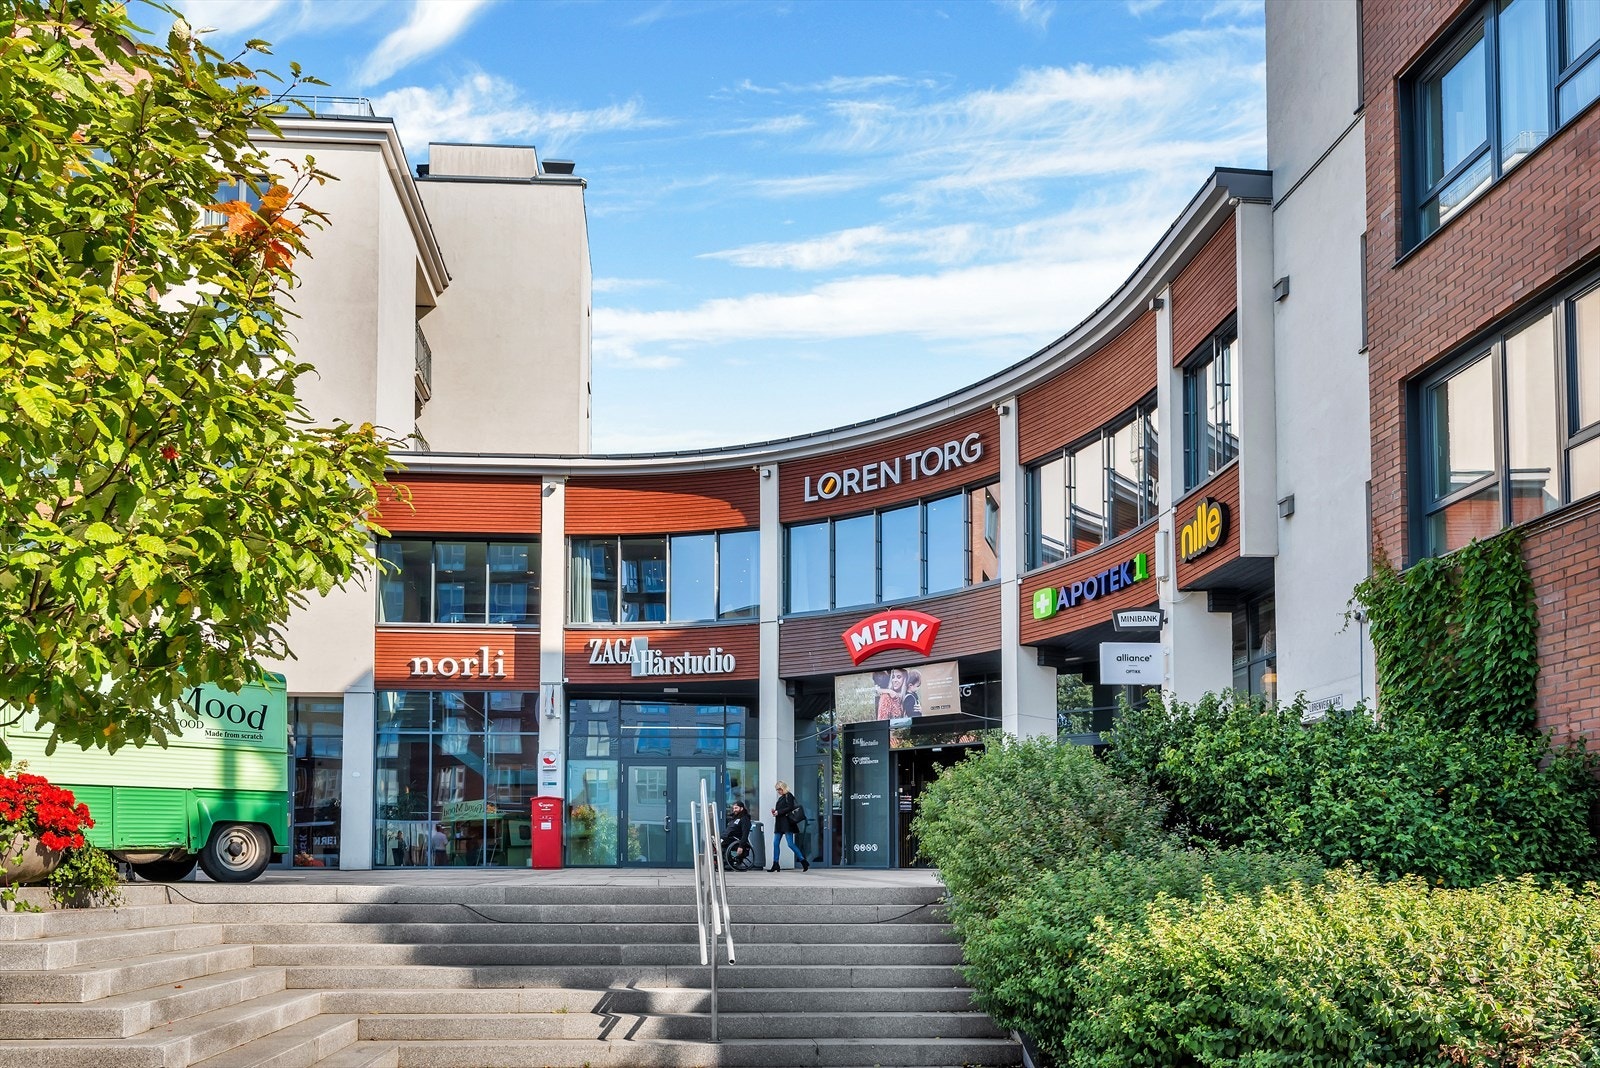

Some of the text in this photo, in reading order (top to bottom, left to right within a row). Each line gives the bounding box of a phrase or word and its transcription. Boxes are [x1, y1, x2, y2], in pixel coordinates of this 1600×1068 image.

[905, 432, 984, 480] TORG
[1180, 502, 1221, 557] nille
[850, 619, 928, 651] MENY
[1120, 615, 1158, 623] MINIBANK
[411, 646, 507, 678] norli
[589, 638, 736, 677] ZAGA Hårstudio
[204, 729, 264, 740] Made from scratch
